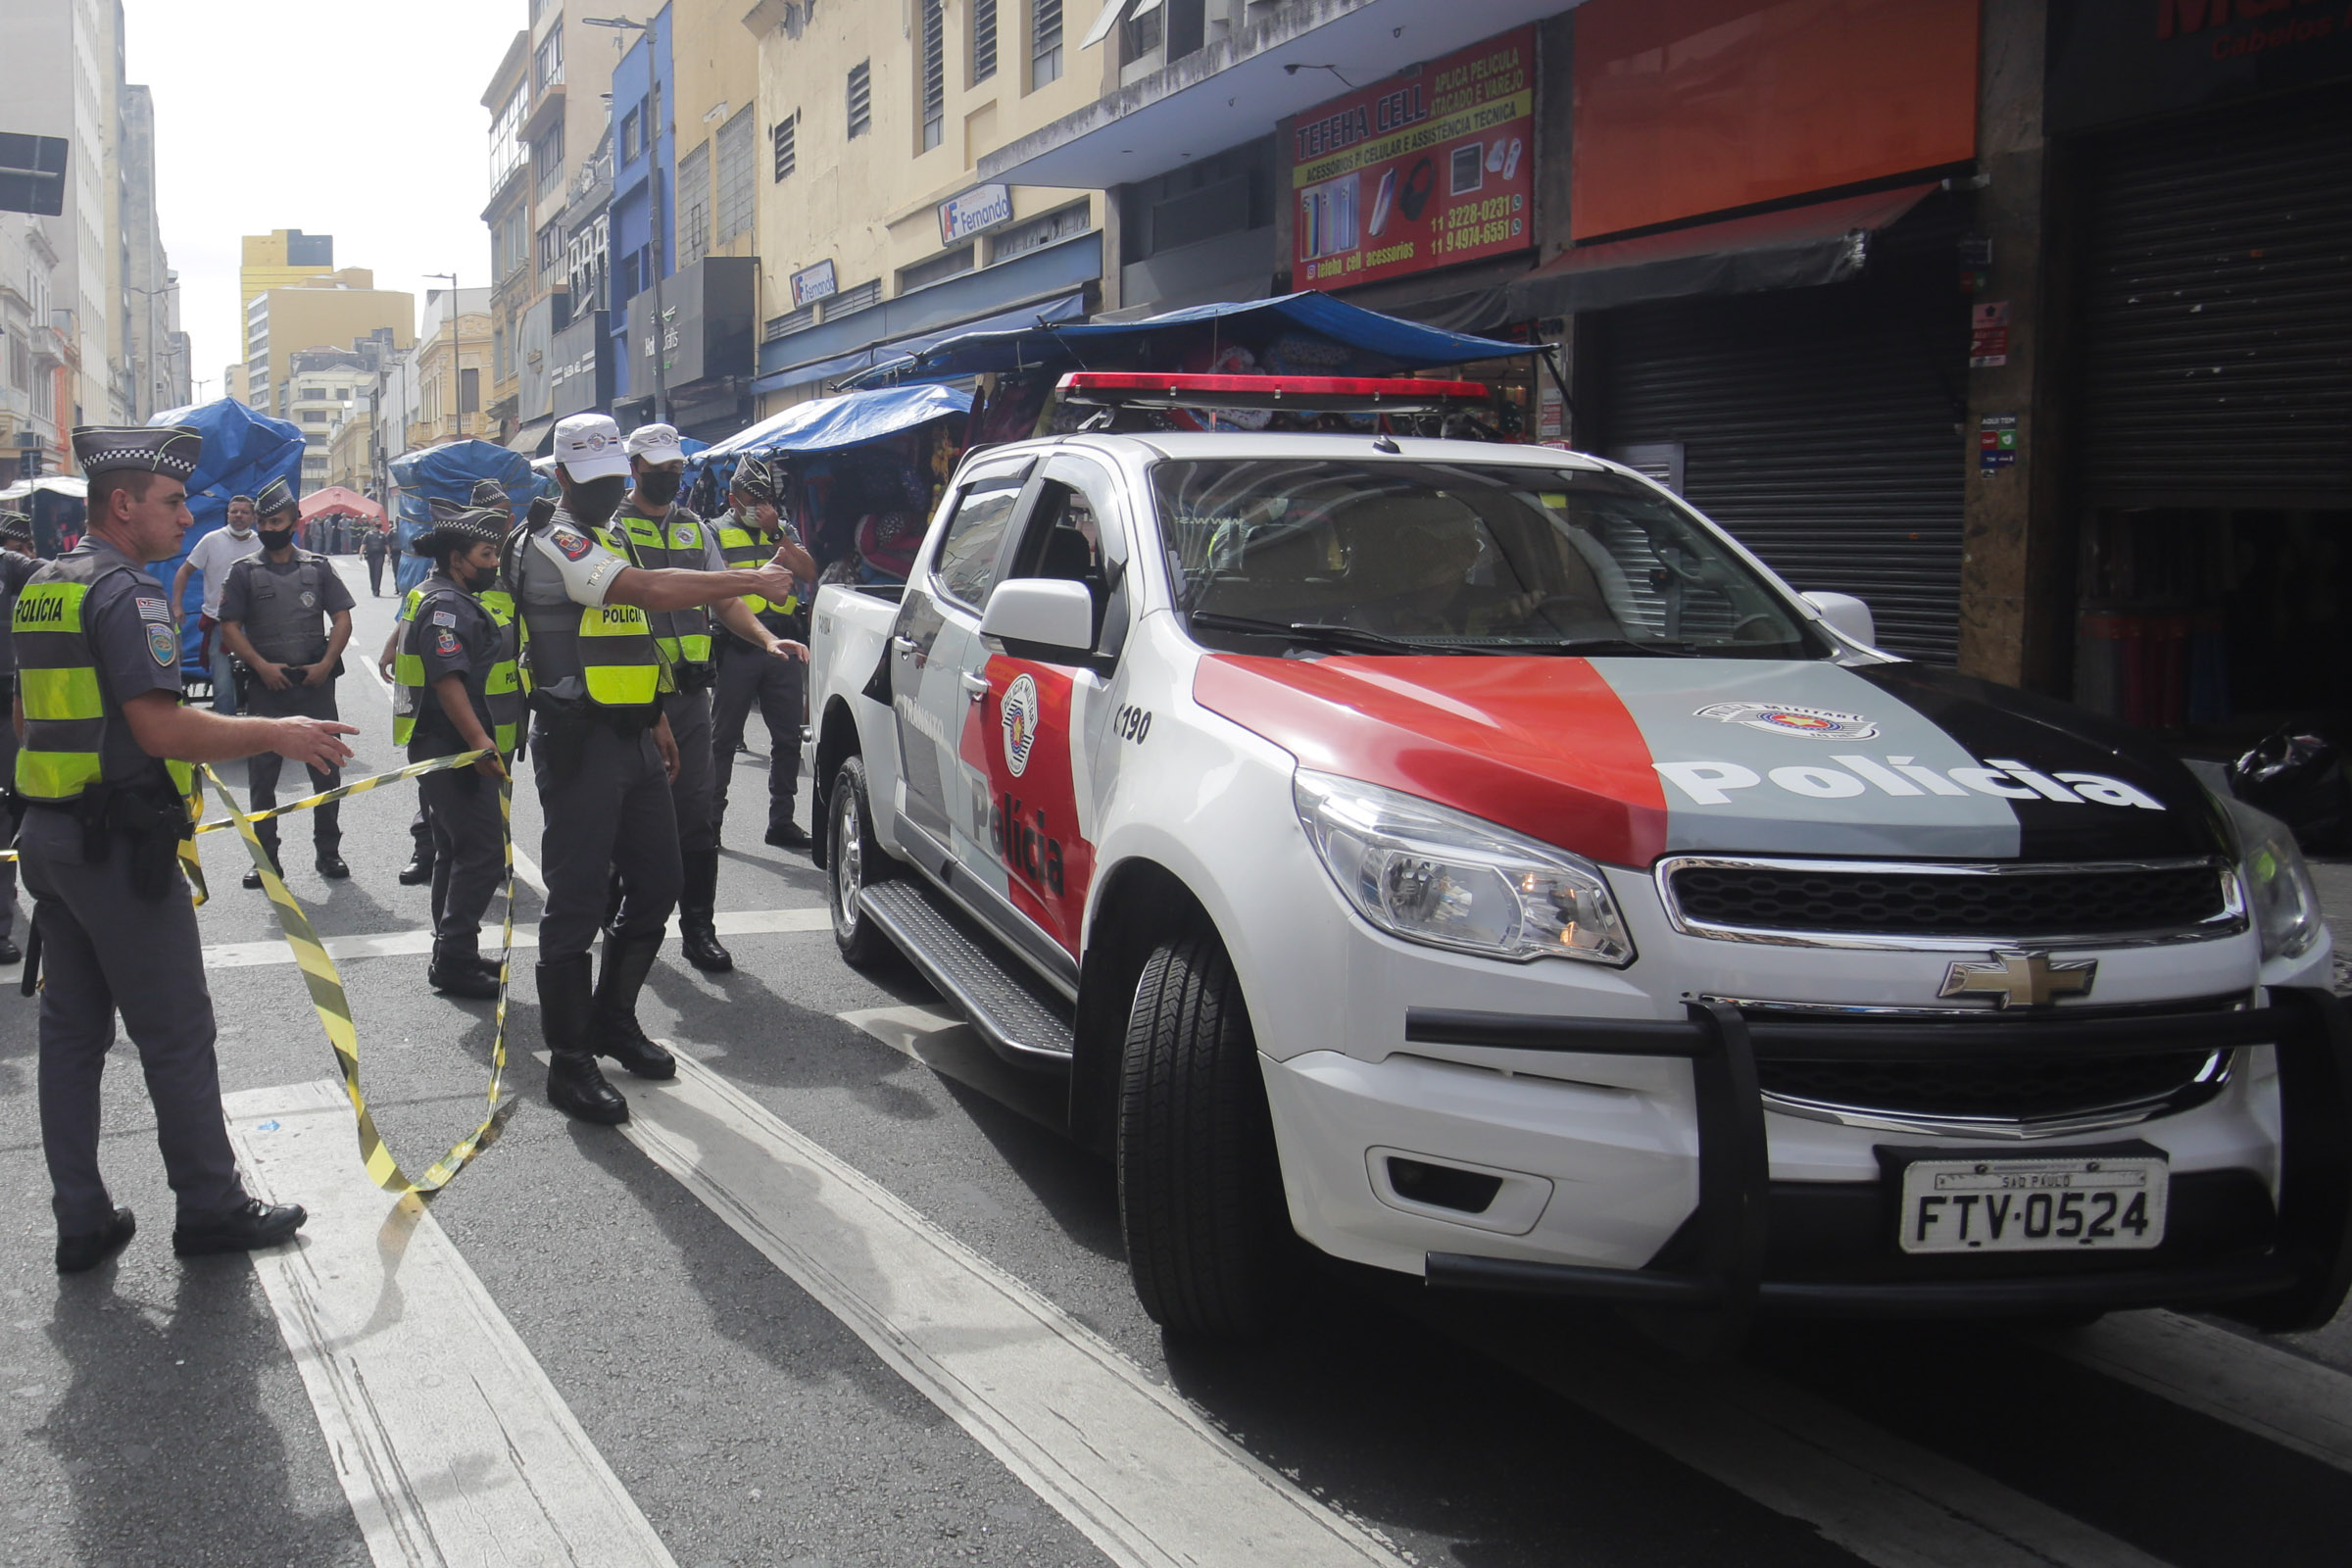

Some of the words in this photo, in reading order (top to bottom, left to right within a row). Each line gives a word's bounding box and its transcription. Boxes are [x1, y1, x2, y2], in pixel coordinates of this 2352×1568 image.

[1432, 86, 1473, 117] ATACADO
[1475, 83, 1483, 103] E
[1485, 68, 1524, 99] VAREJO
[1435, 65, 1468, 94] APLICA
[1297, 105, 1370, 161] TEFEHA
[1377, 83, 1427, 133] CELL
[1364, 138, 1402, 165] CELULAR
[961, 194, 1010, 233] Fernando
[1431, 217, 1444, 232] 11
[1448, 195, 1510, 229] 3228-0231
[1431, 238, 1443, 255] 11
[14, 592, 64, 623] POLÍCIA
[1121, 705, 1152, 745] 190
[1651, 755, 2166, 810] Polícia
[971, 776, 1065, 898] Polícia
[2032, 1176, 2071, 1188] PAULO
